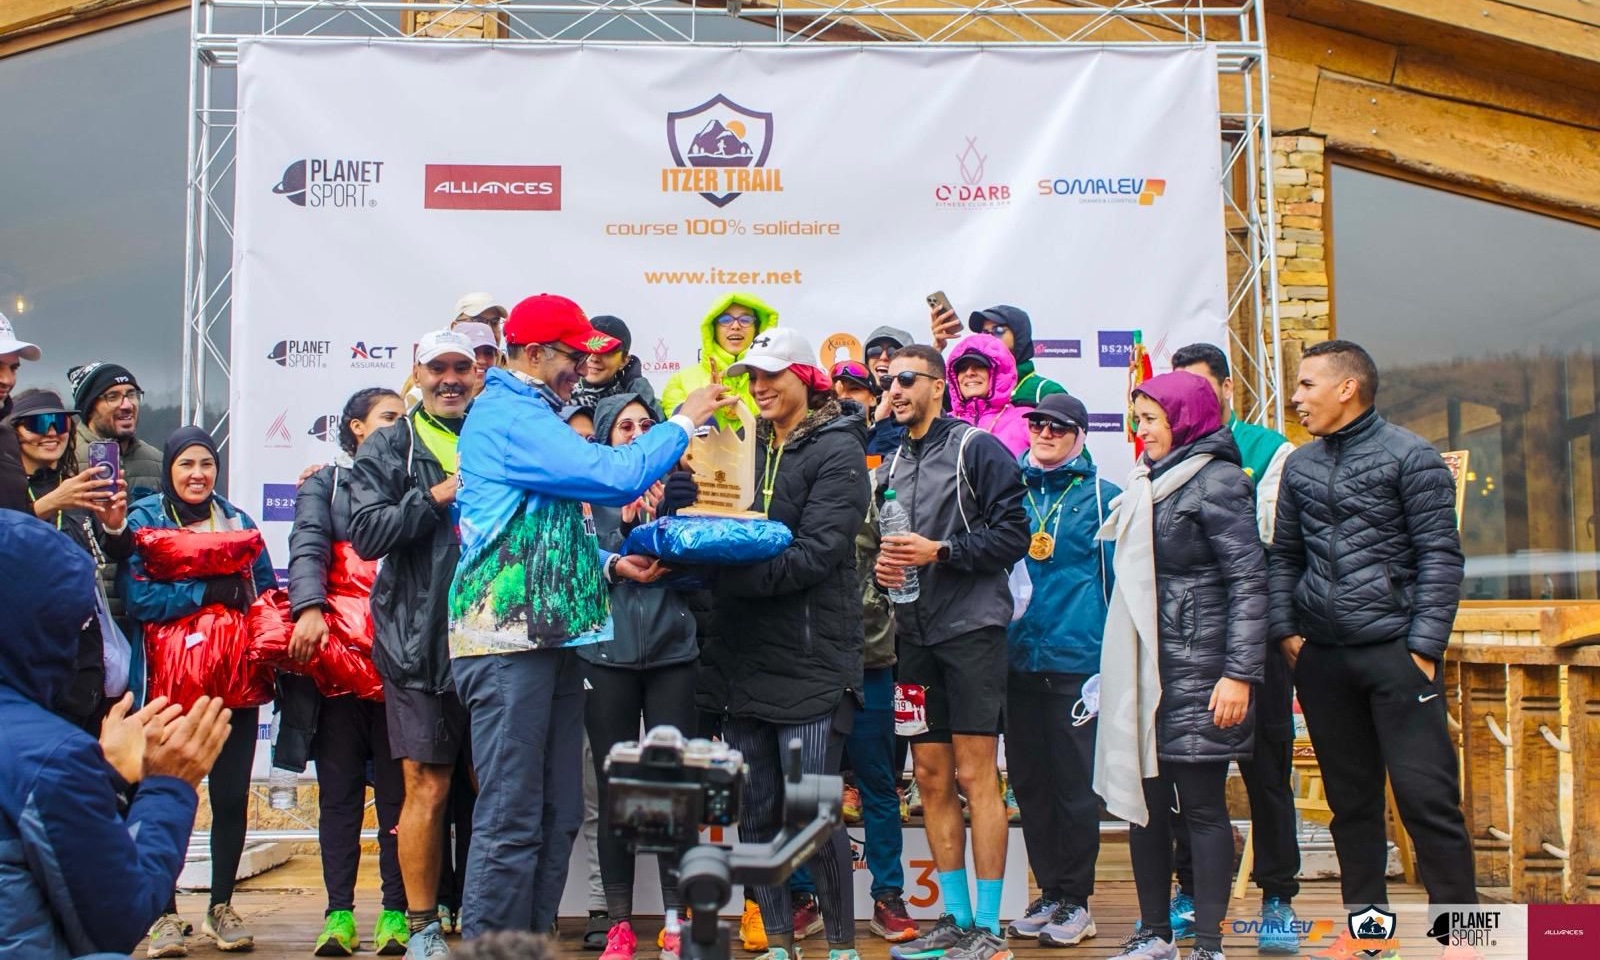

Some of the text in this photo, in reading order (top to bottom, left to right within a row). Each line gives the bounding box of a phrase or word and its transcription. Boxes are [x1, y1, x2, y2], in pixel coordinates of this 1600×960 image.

[311, 159, 384, 183] PLANET
[433, 181, 553, 195] ALLIANCES
[661, 168, 784, 192] ITZER TRAIL
[1038, 178, 1144, 195] SOMALEV
[605, 219, 841, 236] course 100% solidaire
[644, 267, 803, 285] www.itzer.net
[289, 340, 332, 354] PLANET
[350, 361, 396, 369] ASSURANCE
[908, 860, 939, 908] 3
